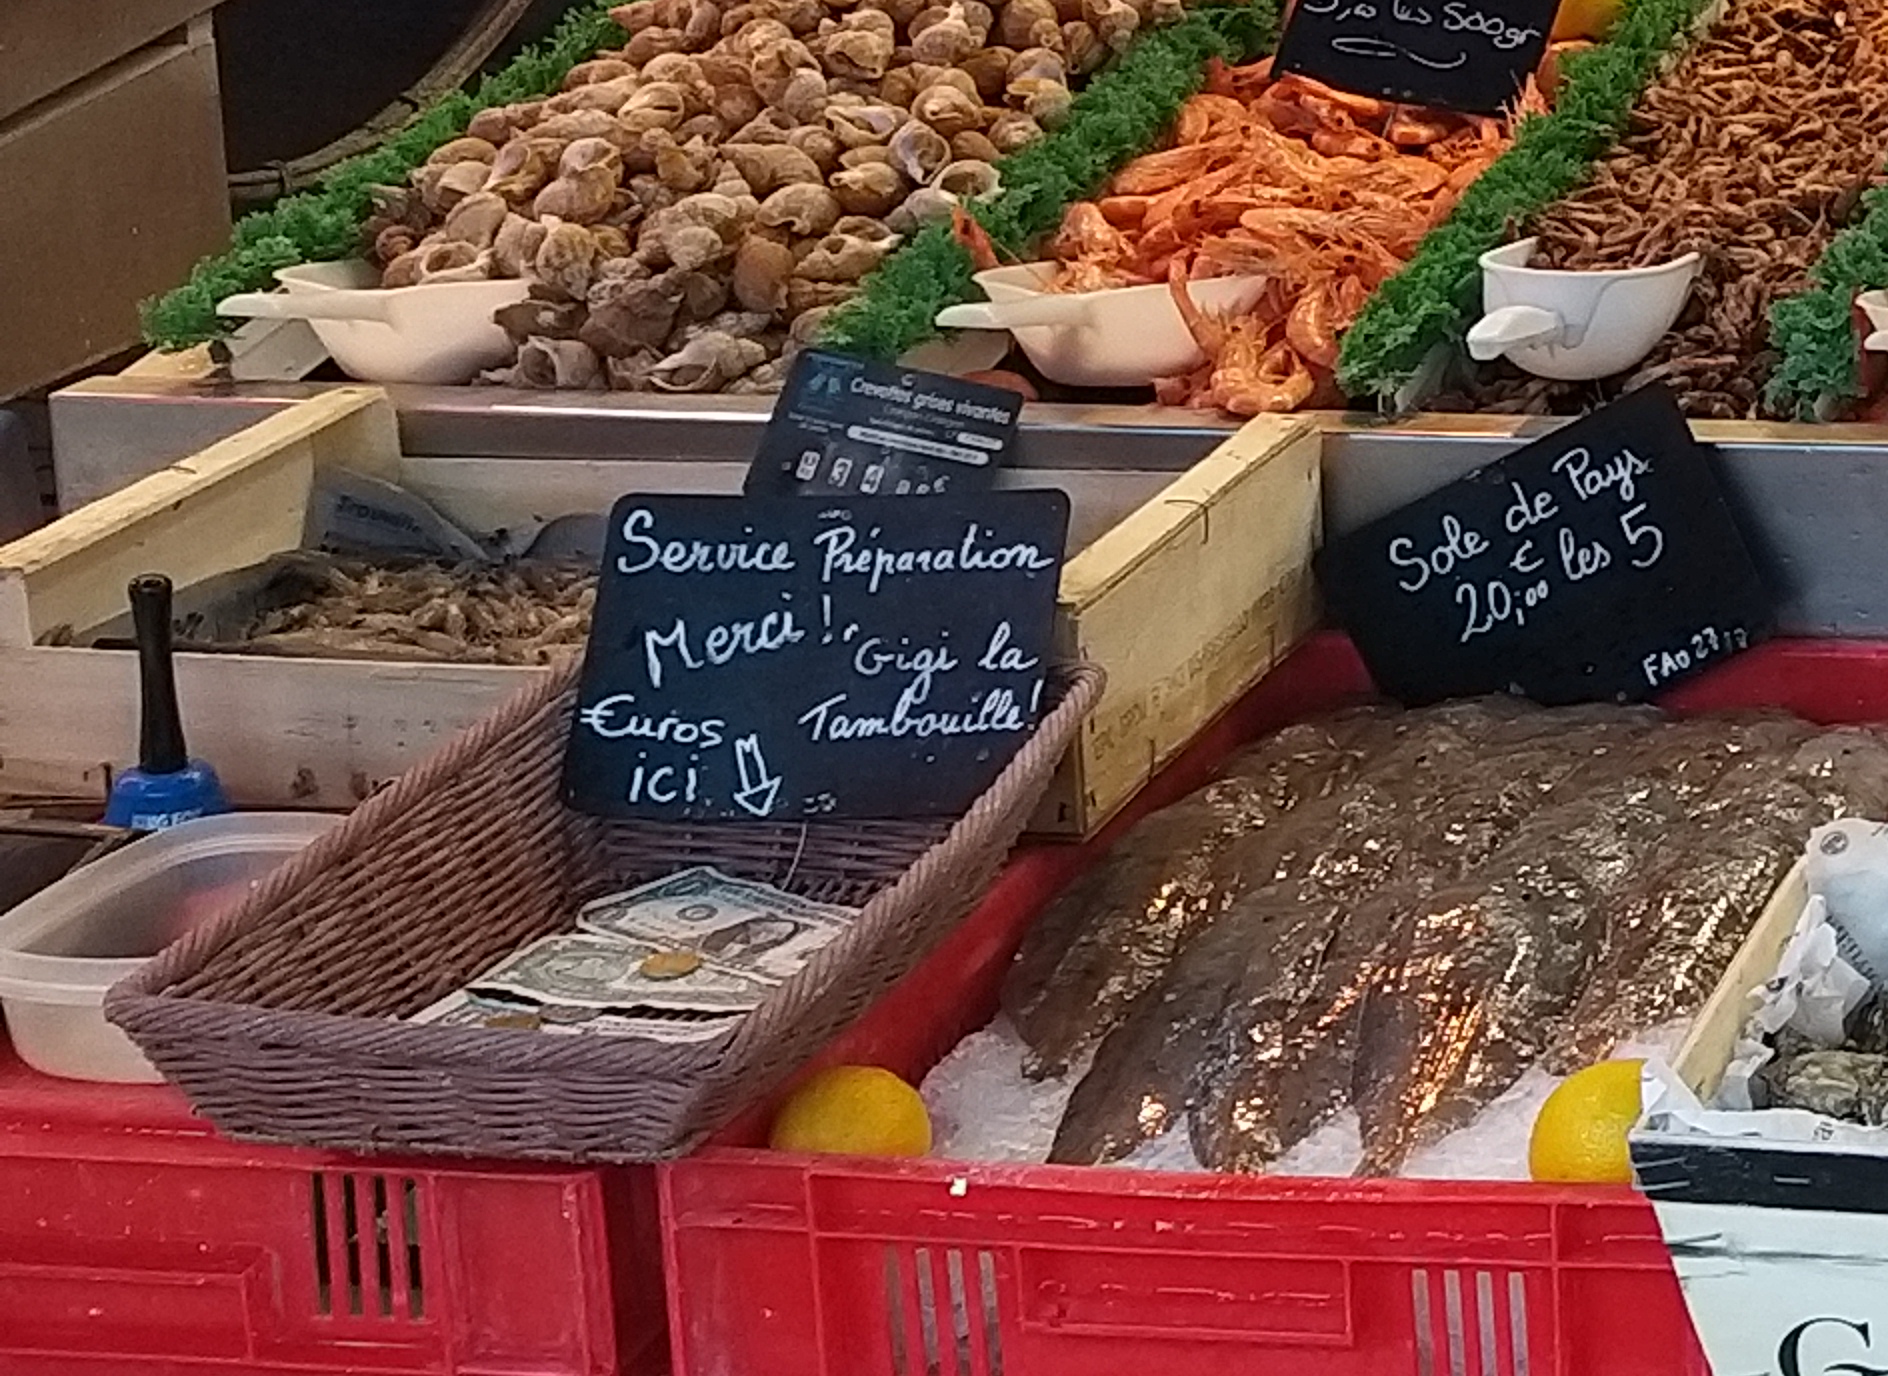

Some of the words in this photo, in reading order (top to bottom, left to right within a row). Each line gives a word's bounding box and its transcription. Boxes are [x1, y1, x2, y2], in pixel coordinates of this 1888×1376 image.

[912, 391, 955, 413] grises
[955, 400, 1011, 425] vivantes
[1388, 514, 1491, 593] Sole
[1504, 481, 1560, 534] de
[1551, 445, 1654, 503] Pays
[1558, 527, 1612, 582] les
[1620, 503, 1664, 568] 5
[618, 509, 796, 574] Service
[813, 523, 1056, 592] Préparation
[1510, 539, 1546, 573] €
[644, 592, 805, 688] Merci
[978, 621, 1039, 672] la
[1642, 648, 1691, 687] FAO
[628, 750, 697, 803] ici
